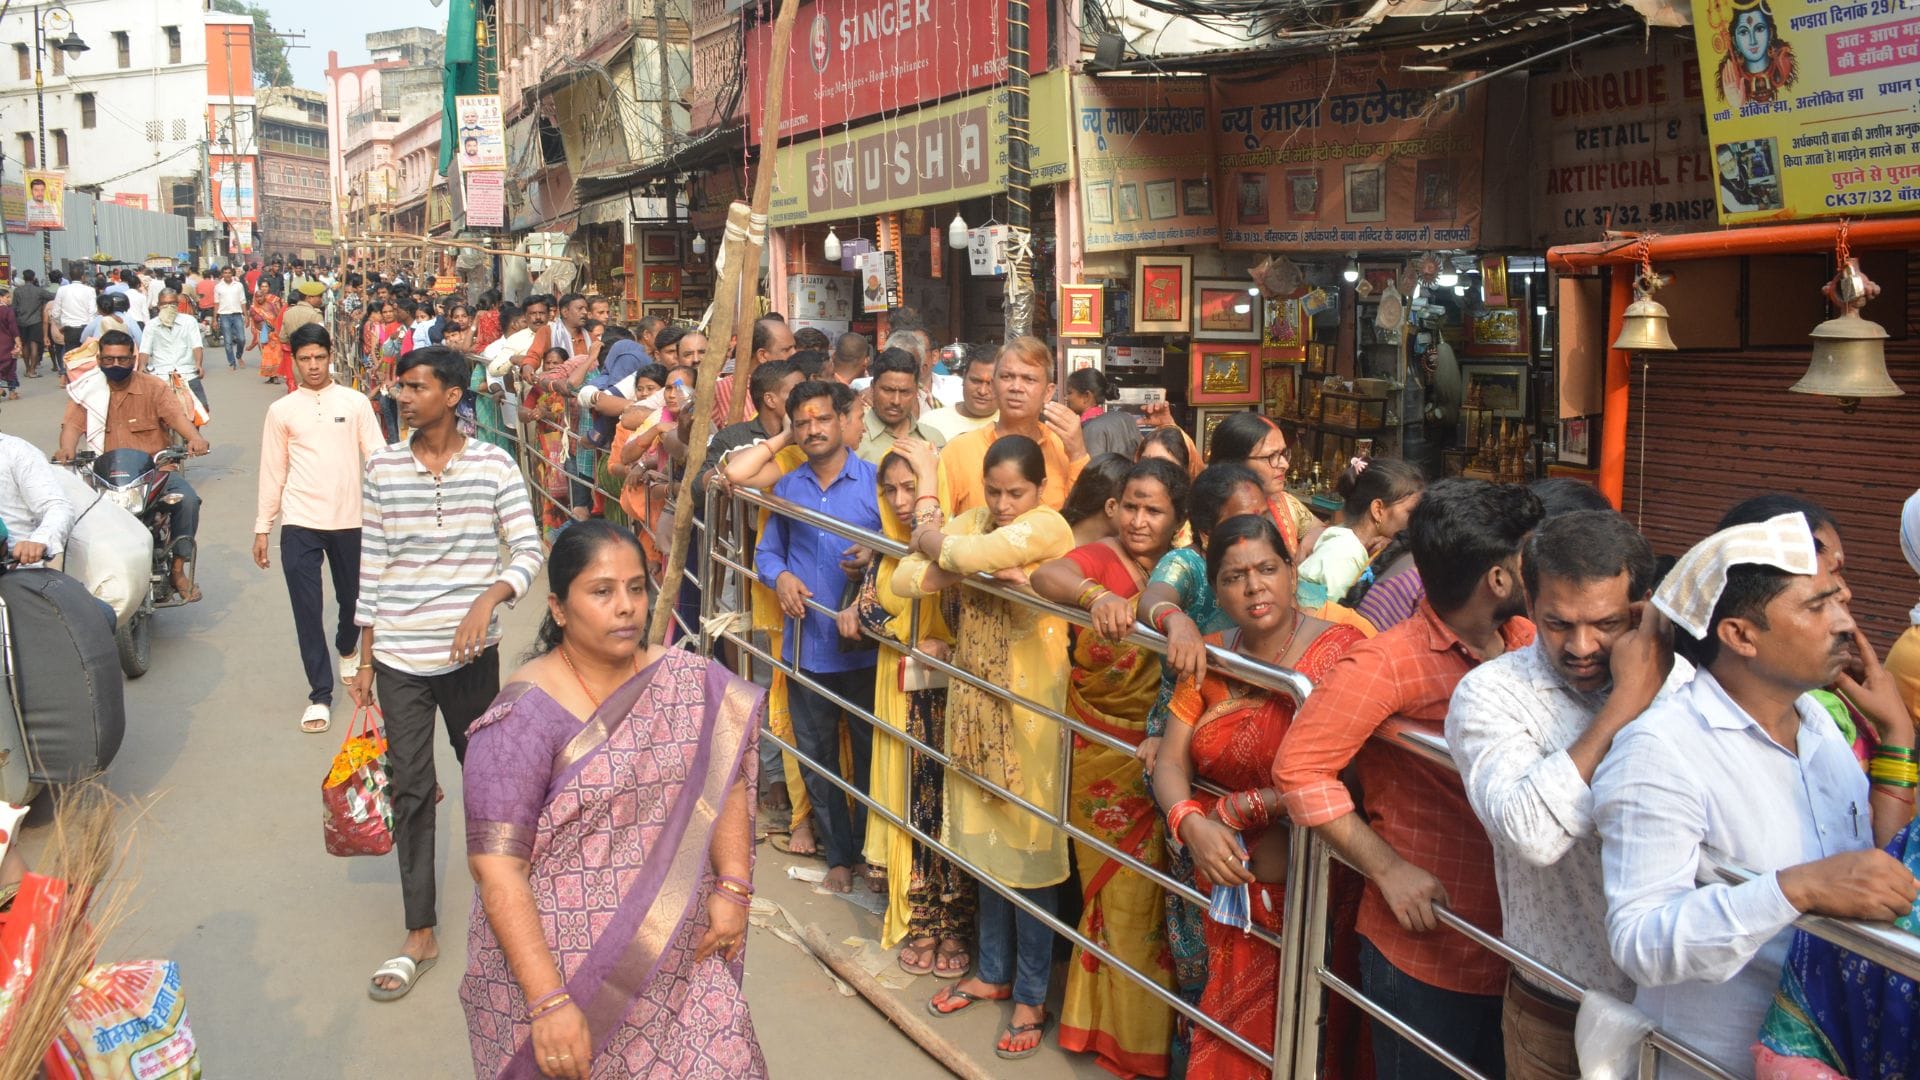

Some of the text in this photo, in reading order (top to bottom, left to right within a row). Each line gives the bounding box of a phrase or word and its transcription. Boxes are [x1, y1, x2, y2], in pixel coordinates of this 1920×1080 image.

[839, 0, 932, 51] SINGER
[1791, 11, 1827, 31] भण्डारा
[1836, 34, 1865, 49] अतः
[1870, 26, 1898, 43] आप
[1837, 52, 1856, 68] की
[1897, 39, 1919, 58] एवं
[813, 57, 930, 101] Sewing Machines Home Appliances
[1551, 64, 1667, 118] UNIQUE
[1739, 102, 1770, 118] अंकित
[1796, 91, 1844, 109] अलोकित
[1848, 88, 1864, 101] झा
[1878, 79, 1911, 96] प्रधान
[1081, 96, 1206, 151] न्यू माया कलेक्शन
[1221, 105, 1260, 149] न्यू
[1260, 97, 1320, 132] माया
[1575, 122, 1650, 151] RETAIL
[1792, 131, 1829, 149] अर्धकपारी
[1831, 131, 1850, 144] बाबा
[1851, 126, 1863, 141] की
[1865, 124, 1893, 140] अशीम
[811, 157, 854, 198] उषा
[864, 123, 981, 191] USHA
[1239, 145, 1272, 168] सामग्री
[1329, 140, 1344, 158] के
[1783, 154, 1803, 167] किया
[1805, 153, 1824, 165] जाता
[1868, 142, 1892, 158] झारने
[1894, 143, 1906, 155] का
[1546, 154, 1713, 195] ARTIFICIAL FL
[1832, 167, 1865, 190] पुराने
[1869, 164, 1882, 181] से
[1825, 190, 1892, 207] CK37/32
[1384, 226, 1393, 241] के
